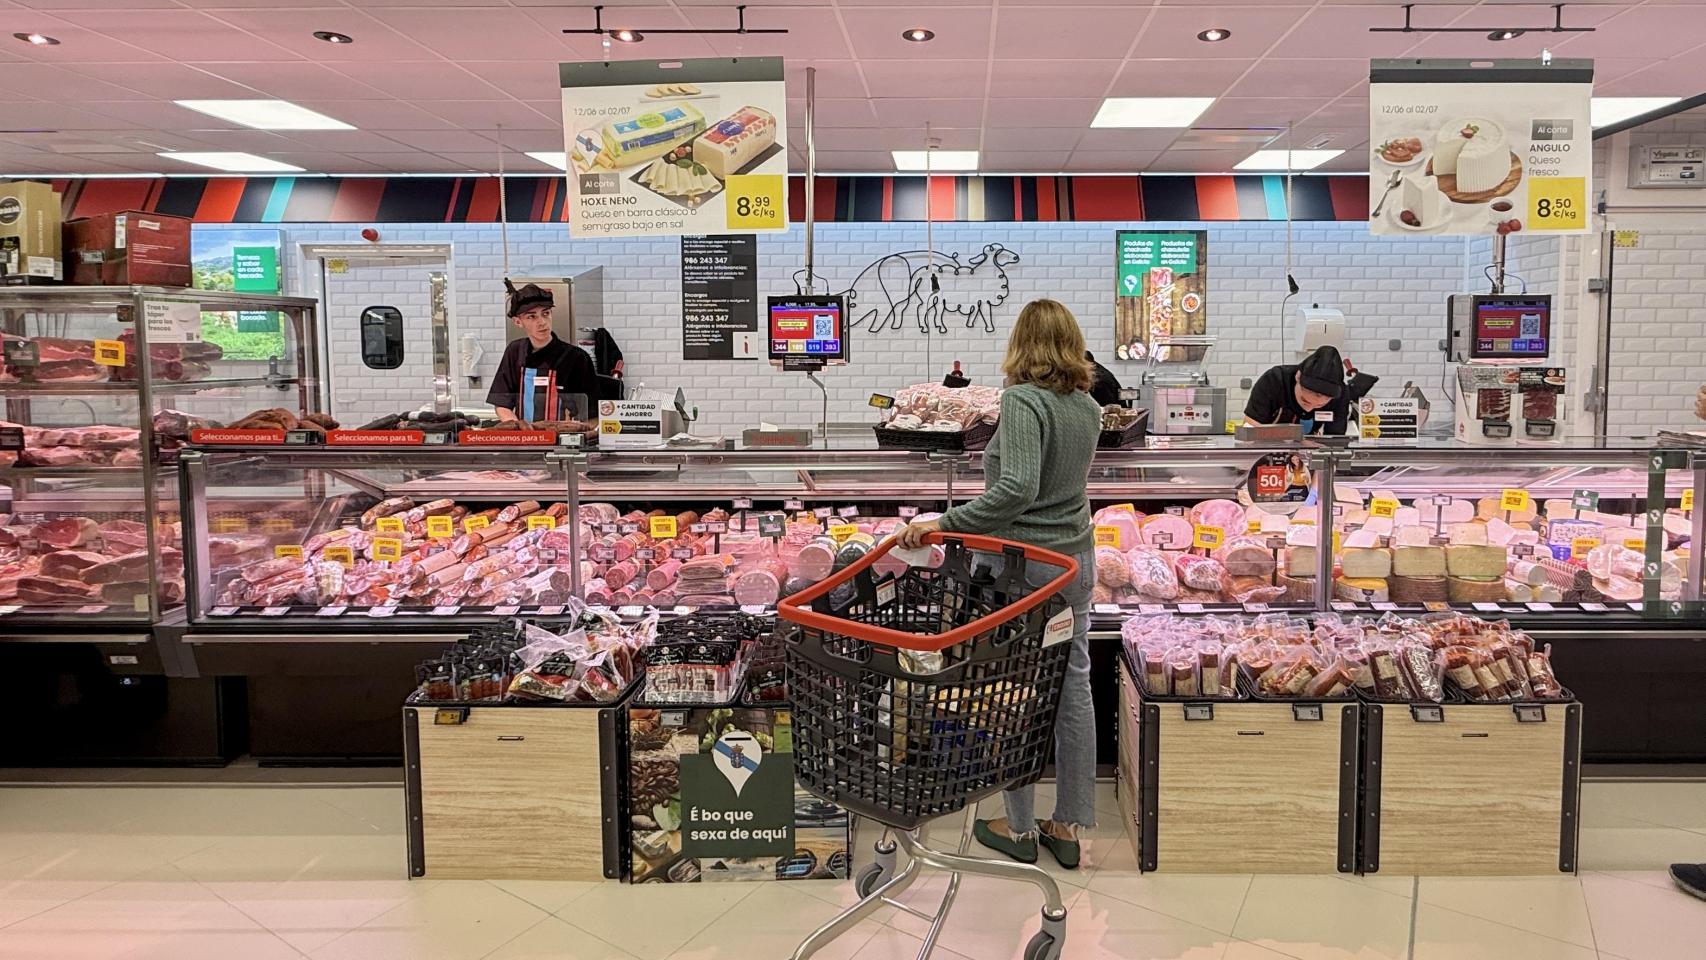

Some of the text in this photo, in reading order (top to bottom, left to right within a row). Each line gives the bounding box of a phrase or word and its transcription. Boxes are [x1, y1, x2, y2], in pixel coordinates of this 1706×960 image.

[574, 107, 597, 116] 12/06
[607, 106, 630, 115] 02/07
[1382, 105, 1438, 114] 12/06 al 02/07
[1546, 126, 1568, 134] corte
[1530, 144, 1571, 152] ANGULO
[1528, 156, 1561, 165] Queso
[1528, 167, 1560, 176] fresco
[593, 180, 615, 188] corte
[580, 196, 637, 206] HOXE NENO
[581, 209, 611, 219] Queso
[627, 208, 653, 217] barra
[655, 207, 688, 216] clásico
[690, 208, 697, 216] o
[752, 207, 775, 219] €/kg
[1553, 208, 1576, 219] €/kg
[582, 222, 631, 232] semigraso
[632, 220, 653, 231] bajo
[669, 219, 684, 228] sal
[200, 433, 253, 441] Seleccionamos
[334, 434, 388, 442] Seleccionamos
[389, 435, 406, 443] para
[1260, 474, 1283, 487] 50€
[690, 806, 754, 824] É bo que
[690, 825, 787, 843] sexa de aquí
